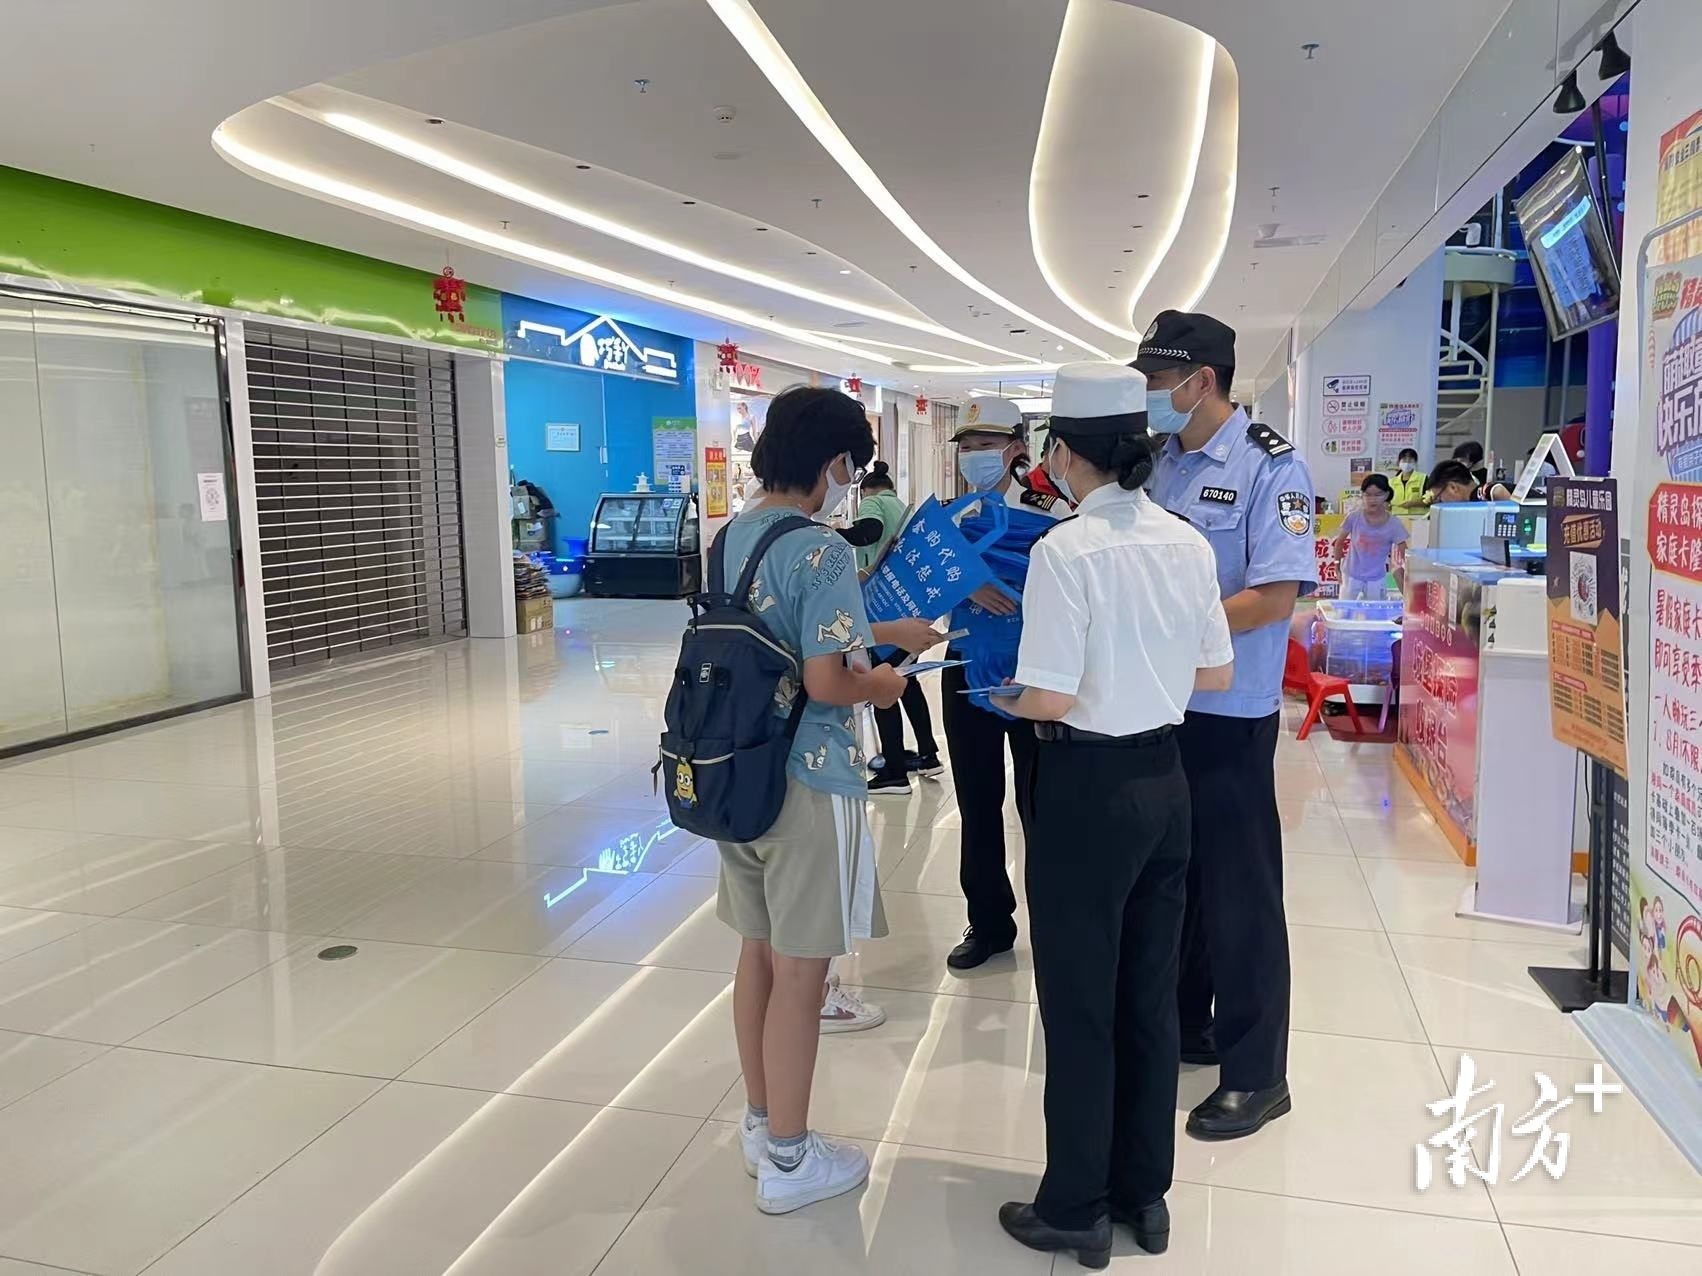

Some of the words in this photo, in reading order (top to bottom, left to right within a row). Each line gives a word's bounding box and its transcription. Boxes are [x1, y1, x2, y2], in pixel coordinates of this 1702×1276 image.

[1202, 488, 1235, 502] 670140
[1566, 488, 1613, 512] 精灵岛儿童乐园
[1563, 519, 1603, 545] 充值优惠活动
[1654, 694, 1702, 732] 一人畅玩三
